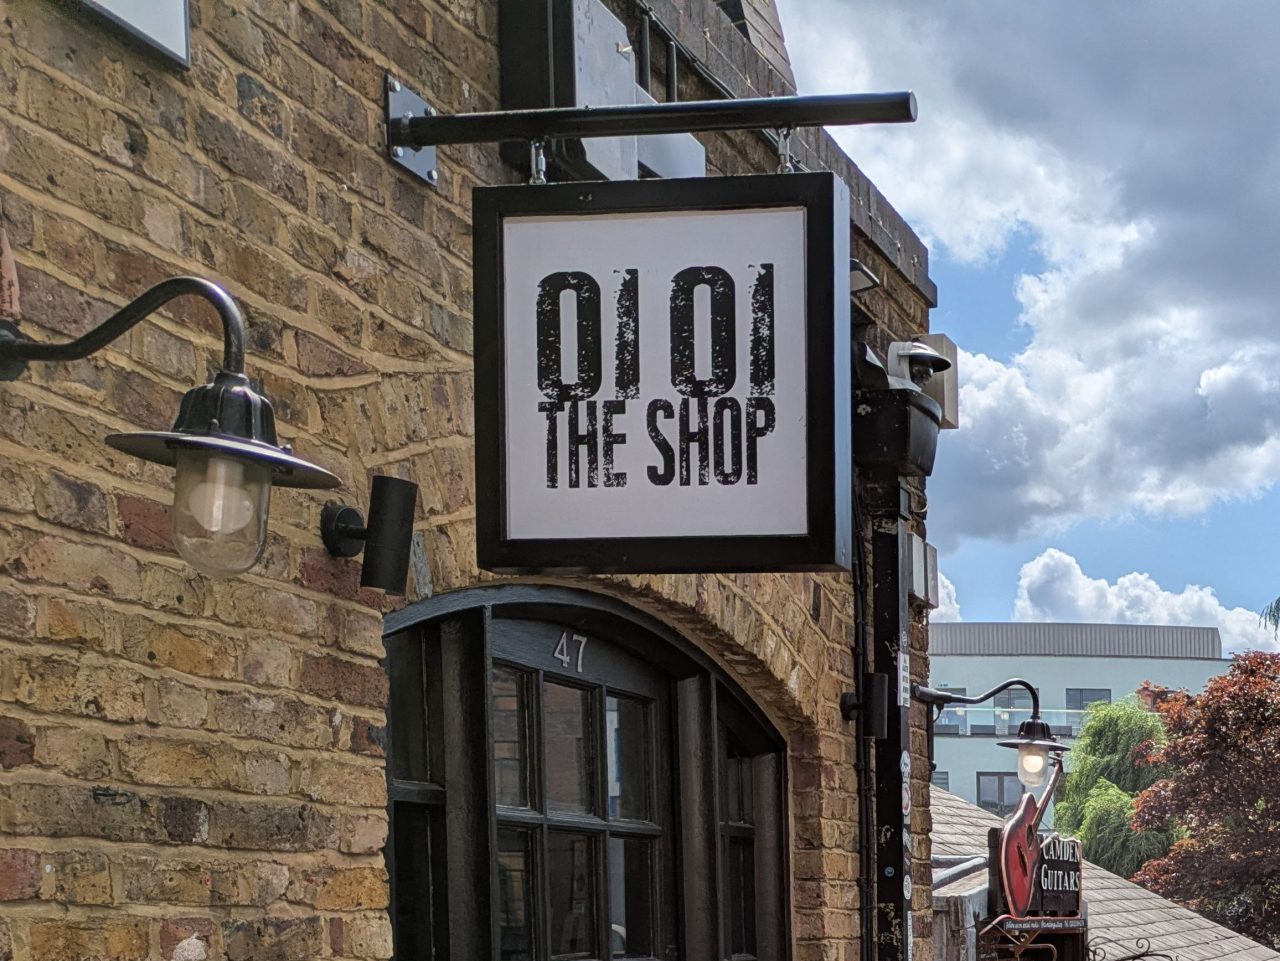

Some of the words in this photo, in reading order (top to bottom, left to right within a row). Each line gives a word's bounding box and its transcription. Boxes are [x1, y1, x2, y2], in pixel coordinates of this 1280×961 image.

[538, 400, 627, 488] THE
[647, 397, 776, 487] SHOP
[553, 631, 587, 673] 47
[1042, 835, 1080, 863] CAMDEN
[1041, 863, 1080, 892] GUITARS
